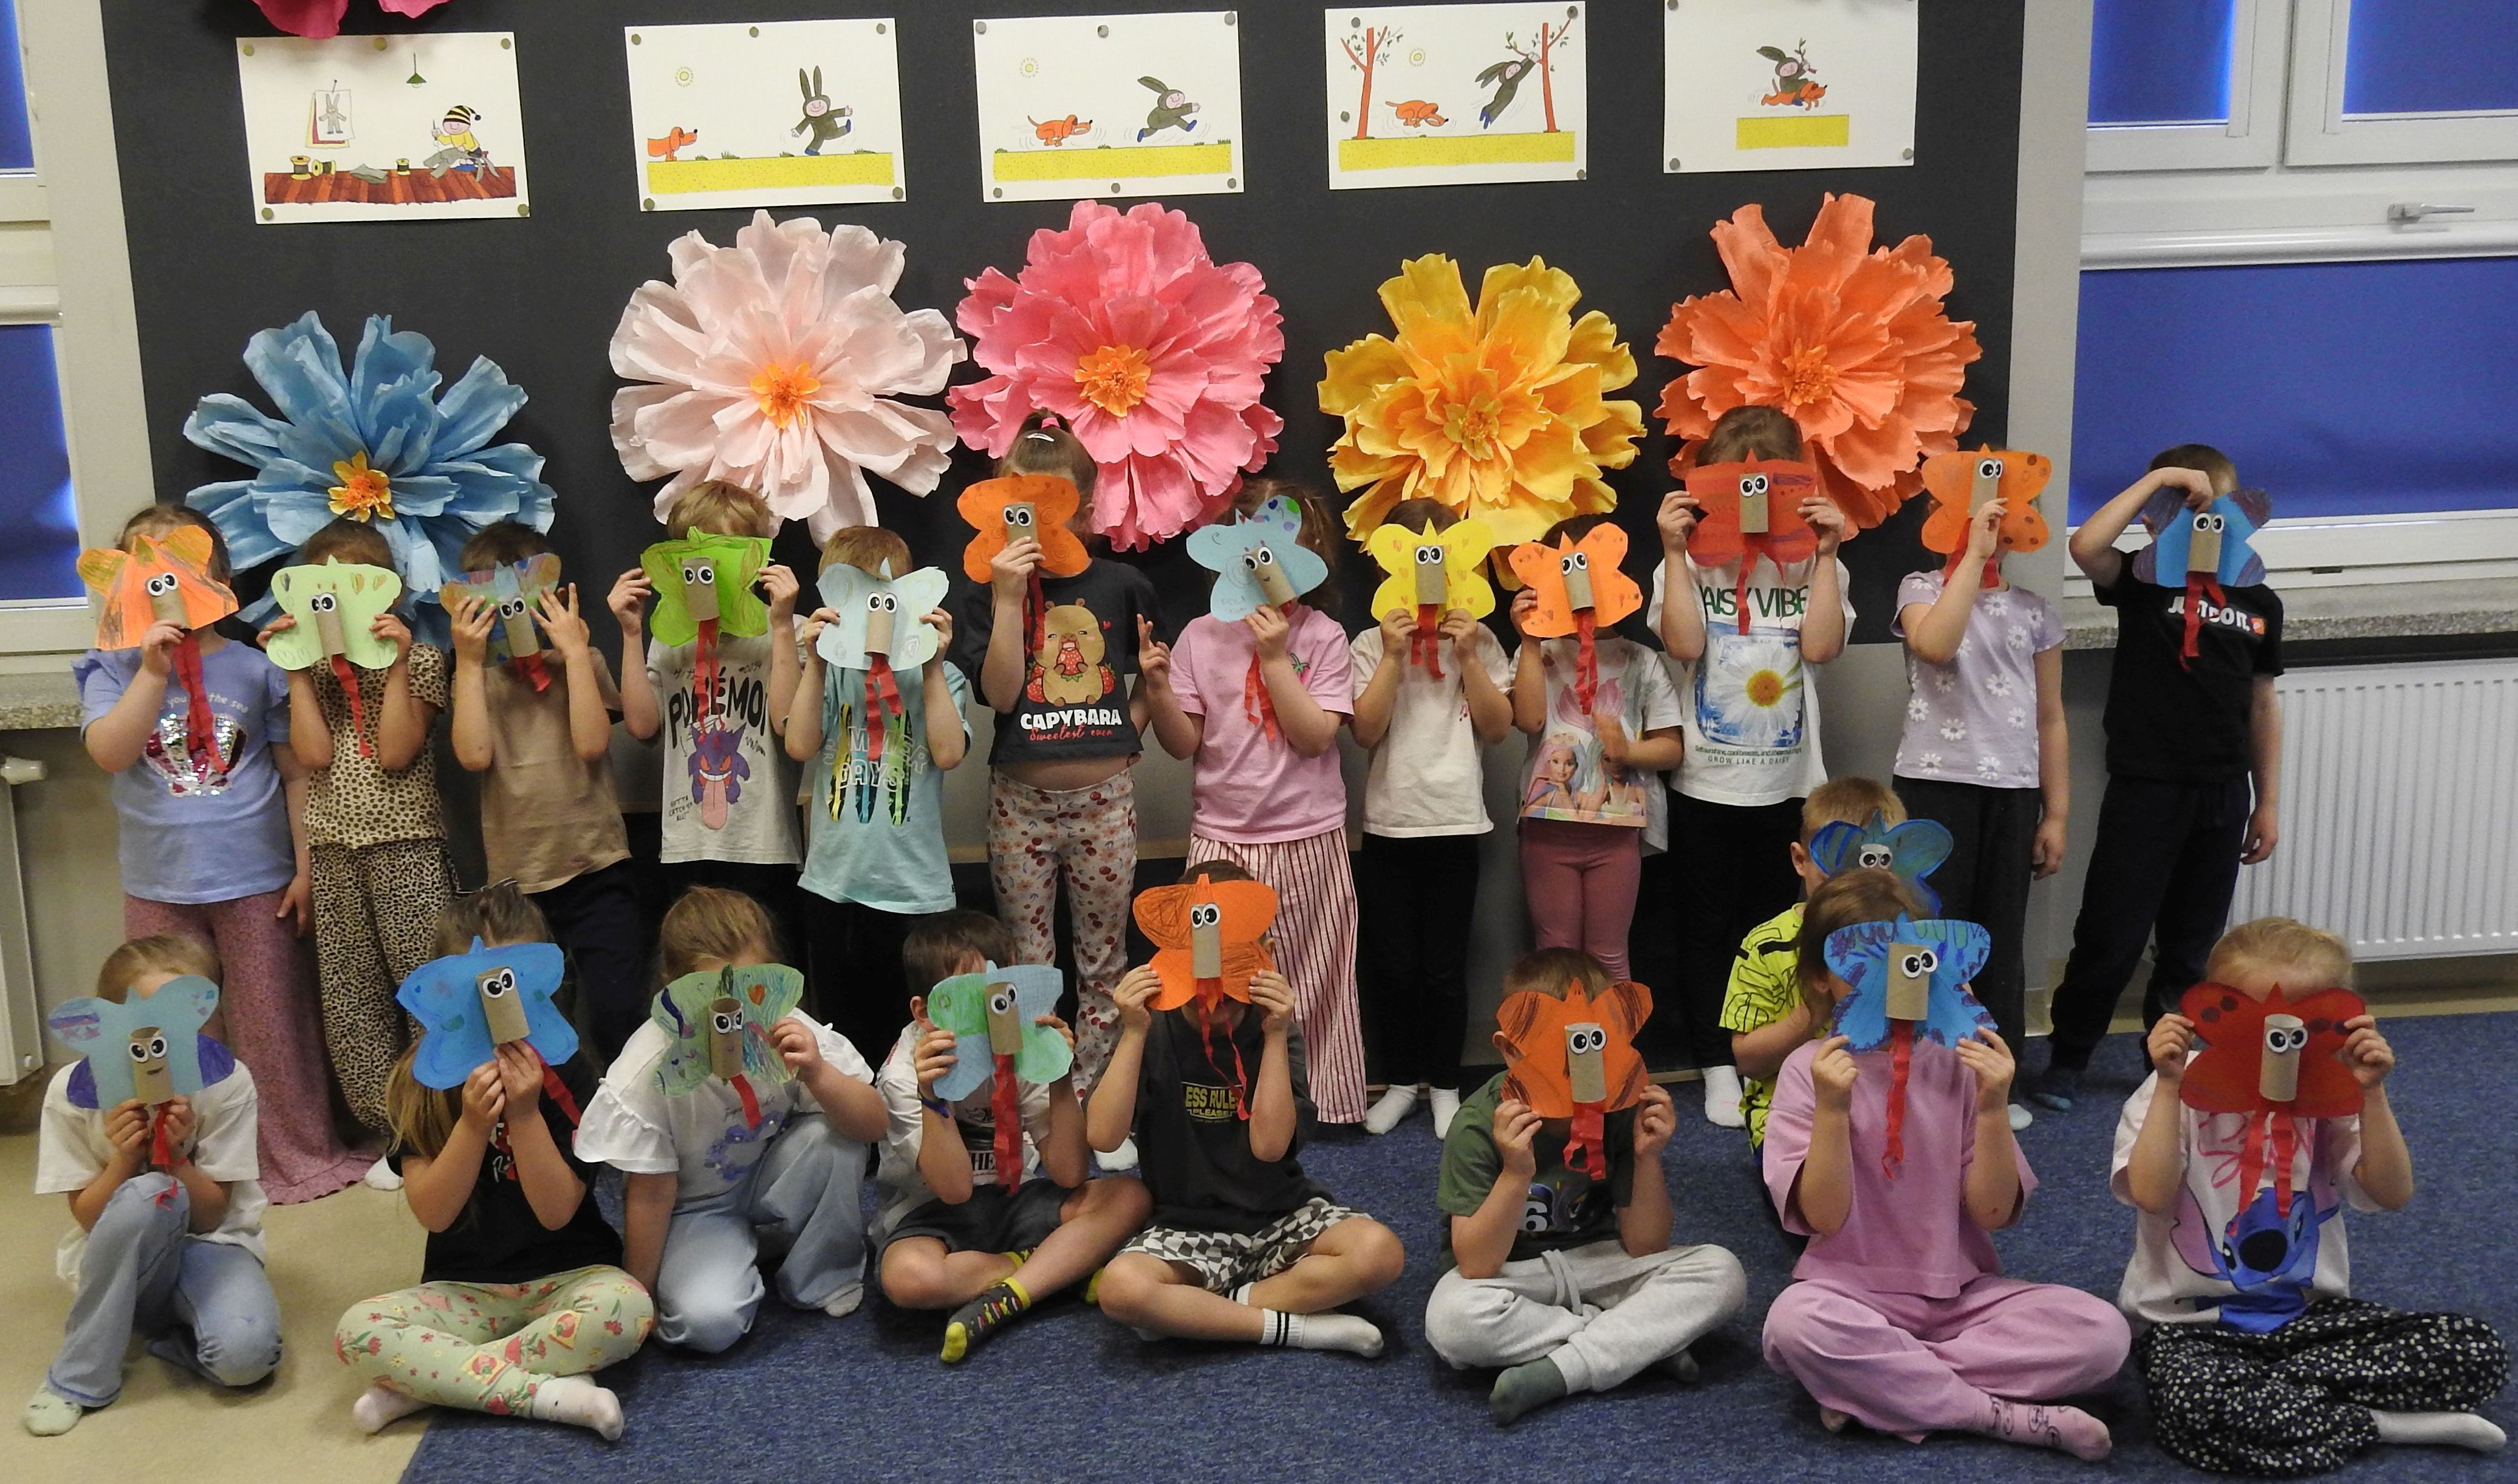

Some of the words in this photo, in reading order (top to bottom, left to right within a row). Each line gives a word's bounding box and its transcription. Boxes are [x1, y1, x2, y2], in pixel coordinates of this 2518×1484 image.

[1701, 586, 1752, 616] AIS
[167, 696, 187, 709] you
[208, 692, 228, 704] the
[1021, 708, 1123, 730] CAPYBARA
[1030, 721, 1086, 741] Sweetest
[822, 725, 931, 775] SMMER
[1708, 755, 1732, 764] GROW
[838, 759, 905, 792] DAYS
[1185, 1086, 1208, 1108] ESS
[1192, 1108, 1229, 1117] PLEASE
